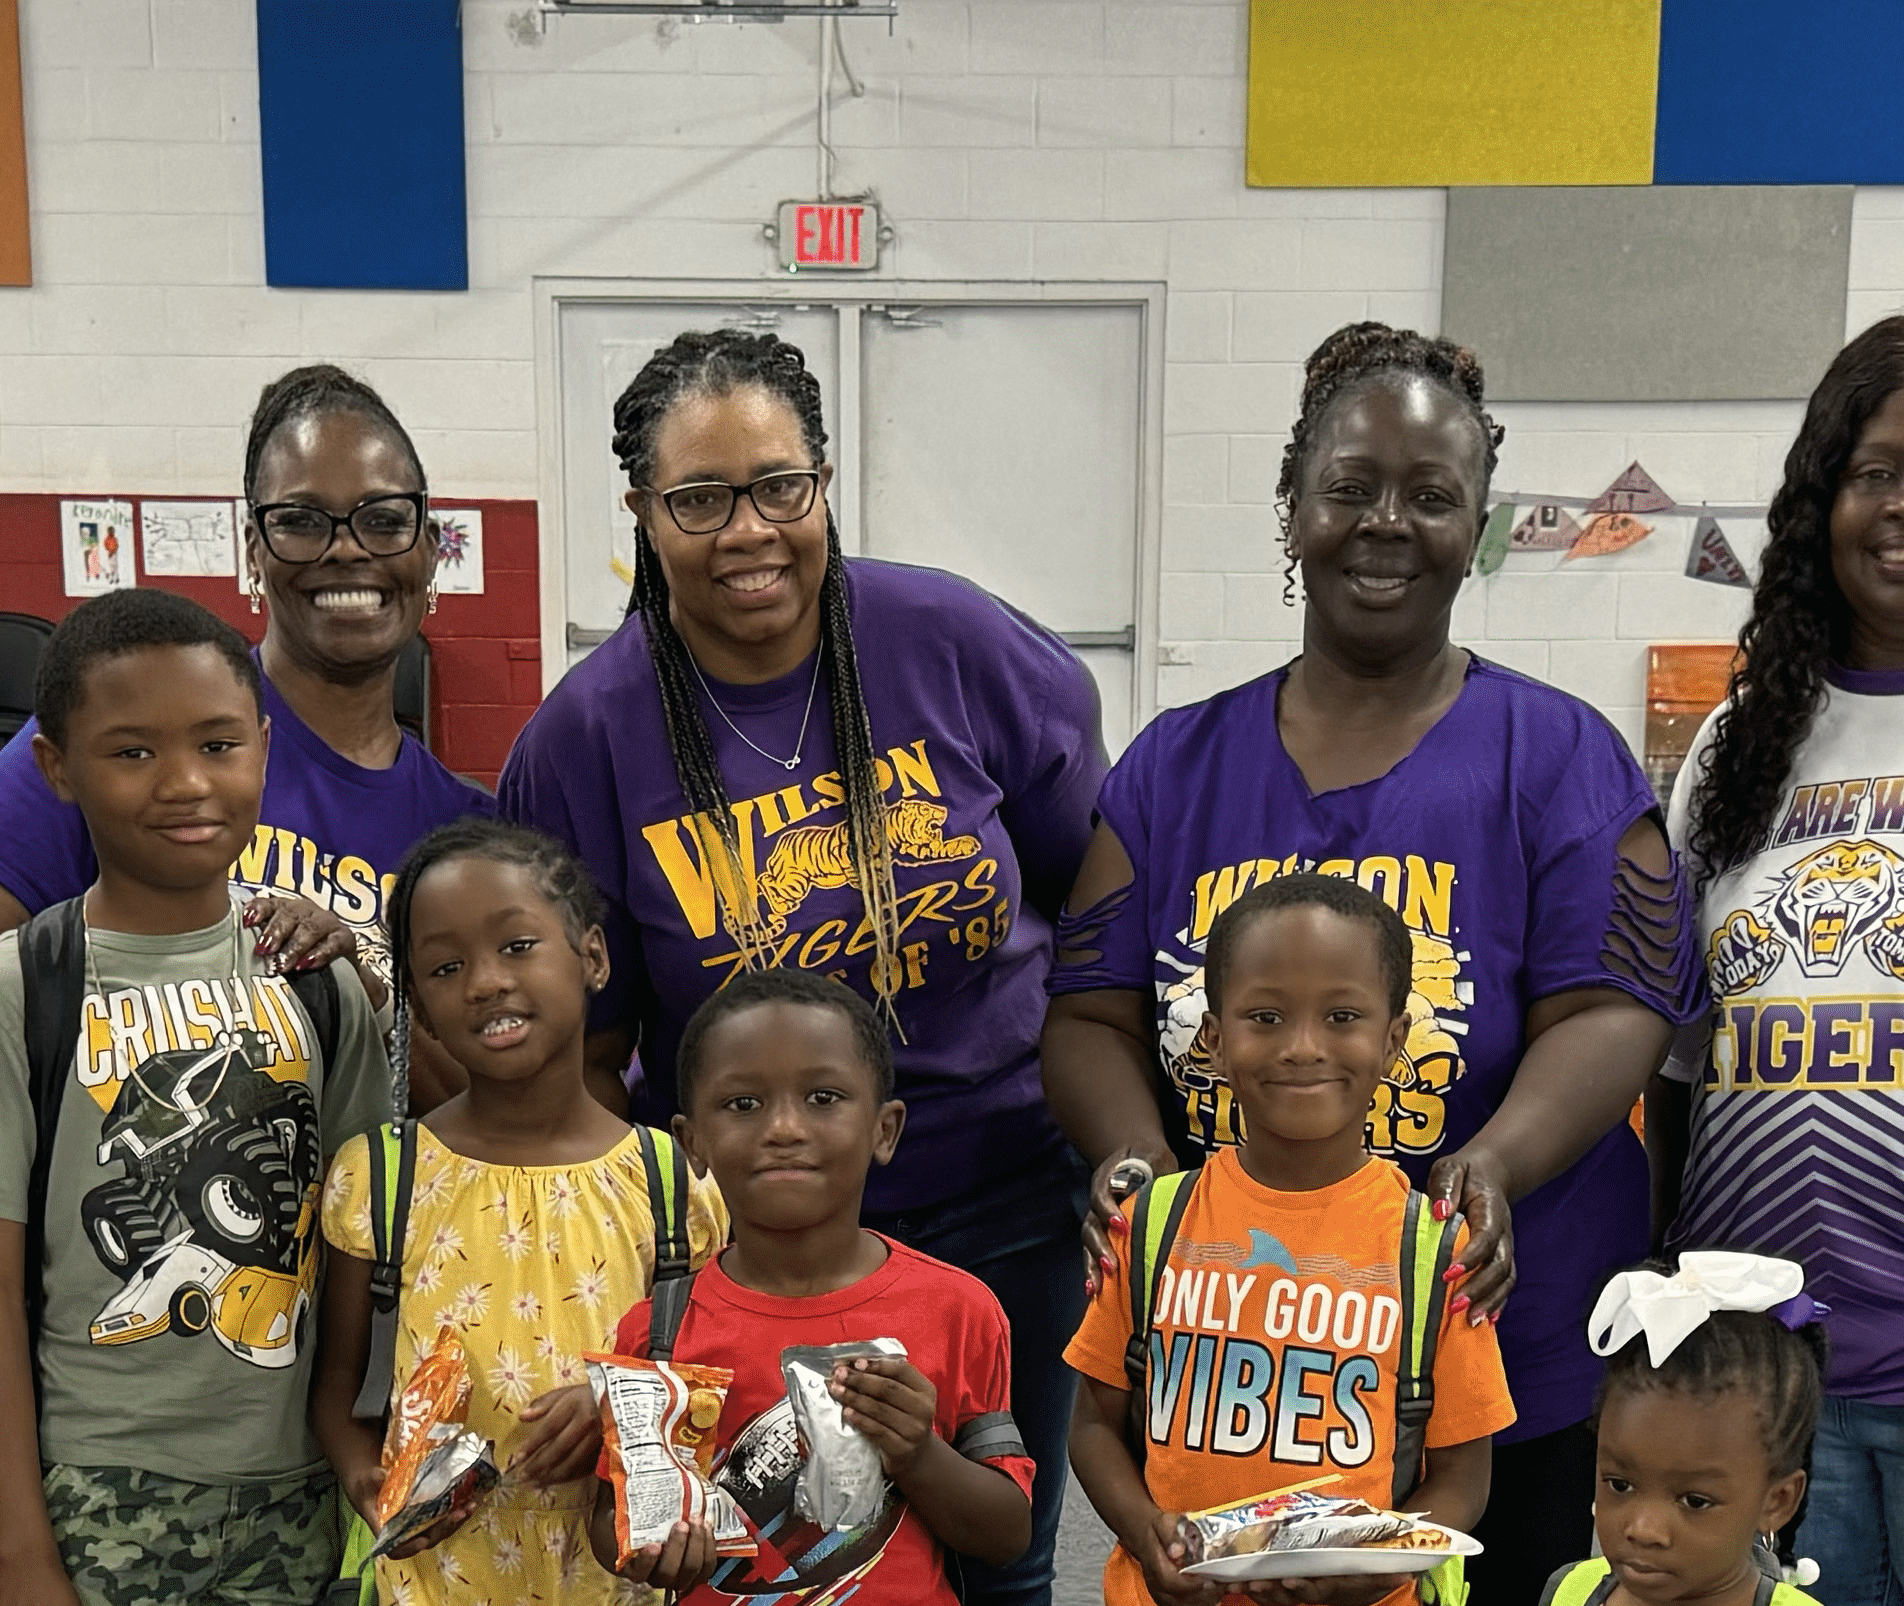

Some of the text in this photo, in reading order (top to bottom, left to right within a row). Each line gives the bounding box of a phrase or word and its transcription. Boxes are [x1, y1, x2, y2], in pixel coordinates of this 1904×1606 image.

[796, 205, 864, 264] EXIT
[1772, 778, 1871, 849] ARE
[227, 824, 396, 926] WILS
[1192, 853, 1457, 941] WON
[870, 942, 929, 996] OF
[1713, 943, 1778, 990] ODAY
[77, 974, 258, 1088] CRUSH
[1152, 1264, 1401, 1355] ONLY GOOD
[1148, 1328, 1381, 1470] VIBES
